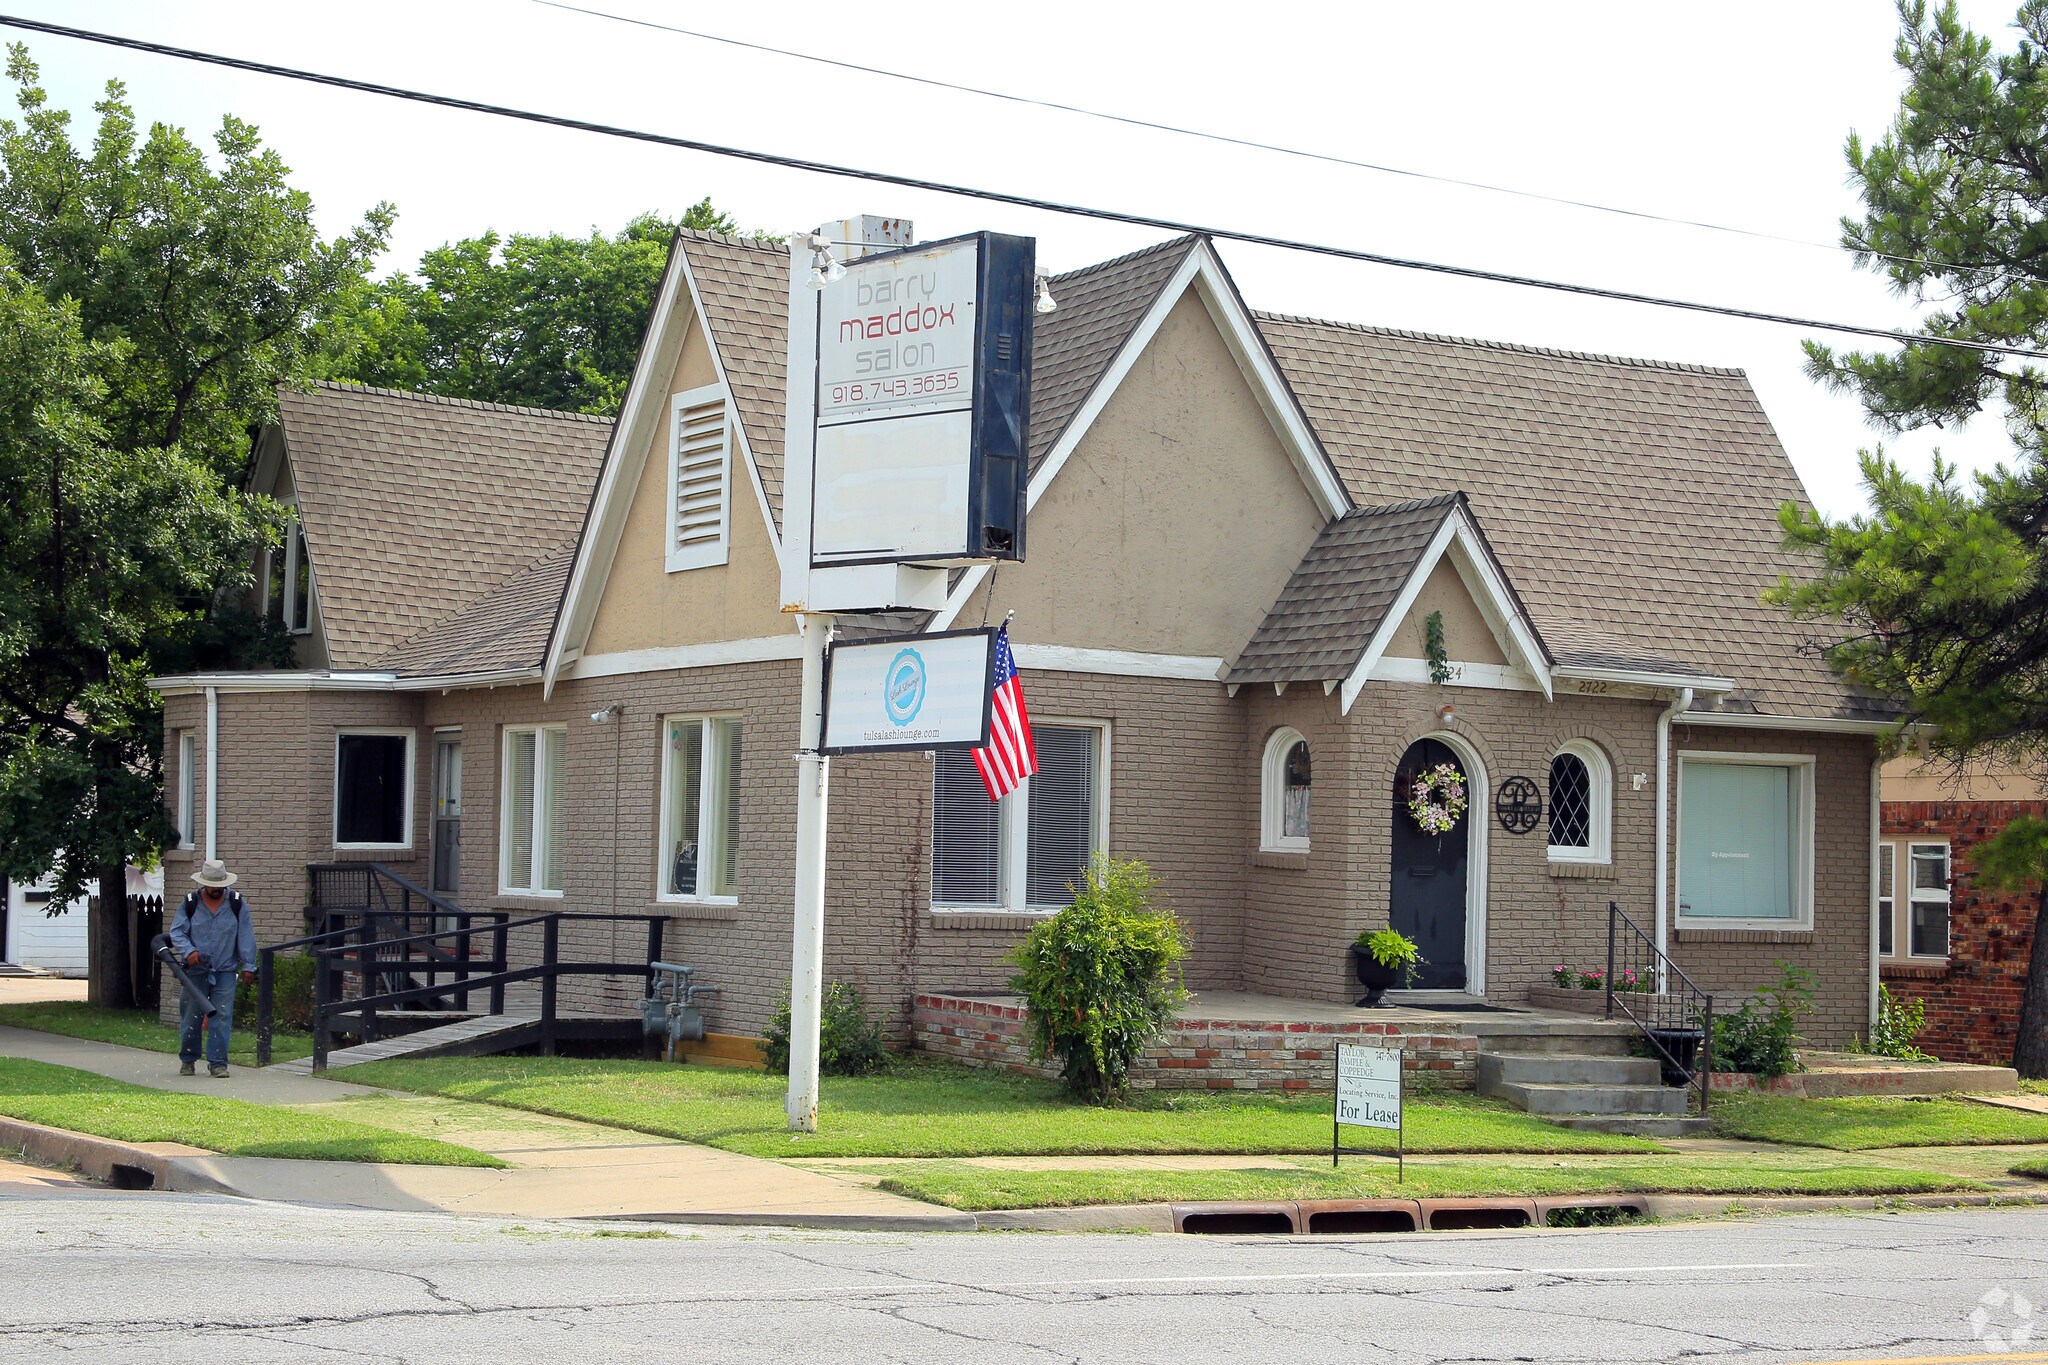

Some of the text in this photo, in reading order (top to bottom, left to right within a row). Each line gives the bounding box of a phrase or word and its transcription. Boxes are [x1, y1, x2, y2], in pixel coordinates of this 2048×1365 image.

[857, 271, 936, 307] barry
[839, 302, 954, 343] maddox
[855, 340, 935, 374] salon
[832, 371, 959, 404] 918.743.3635
[1578, 680, 1607, 694] 2722
[863, 728, 940, 741] tulsalashlounge.com
[1339, 1066, 1374, 1077] COPPEDGE
[1340, 1057, 1364, 1067] SAMPLE
[1339, 1087, 1363, 1098] Locating
[1340, 1099, 1398, 1123] For Lease
